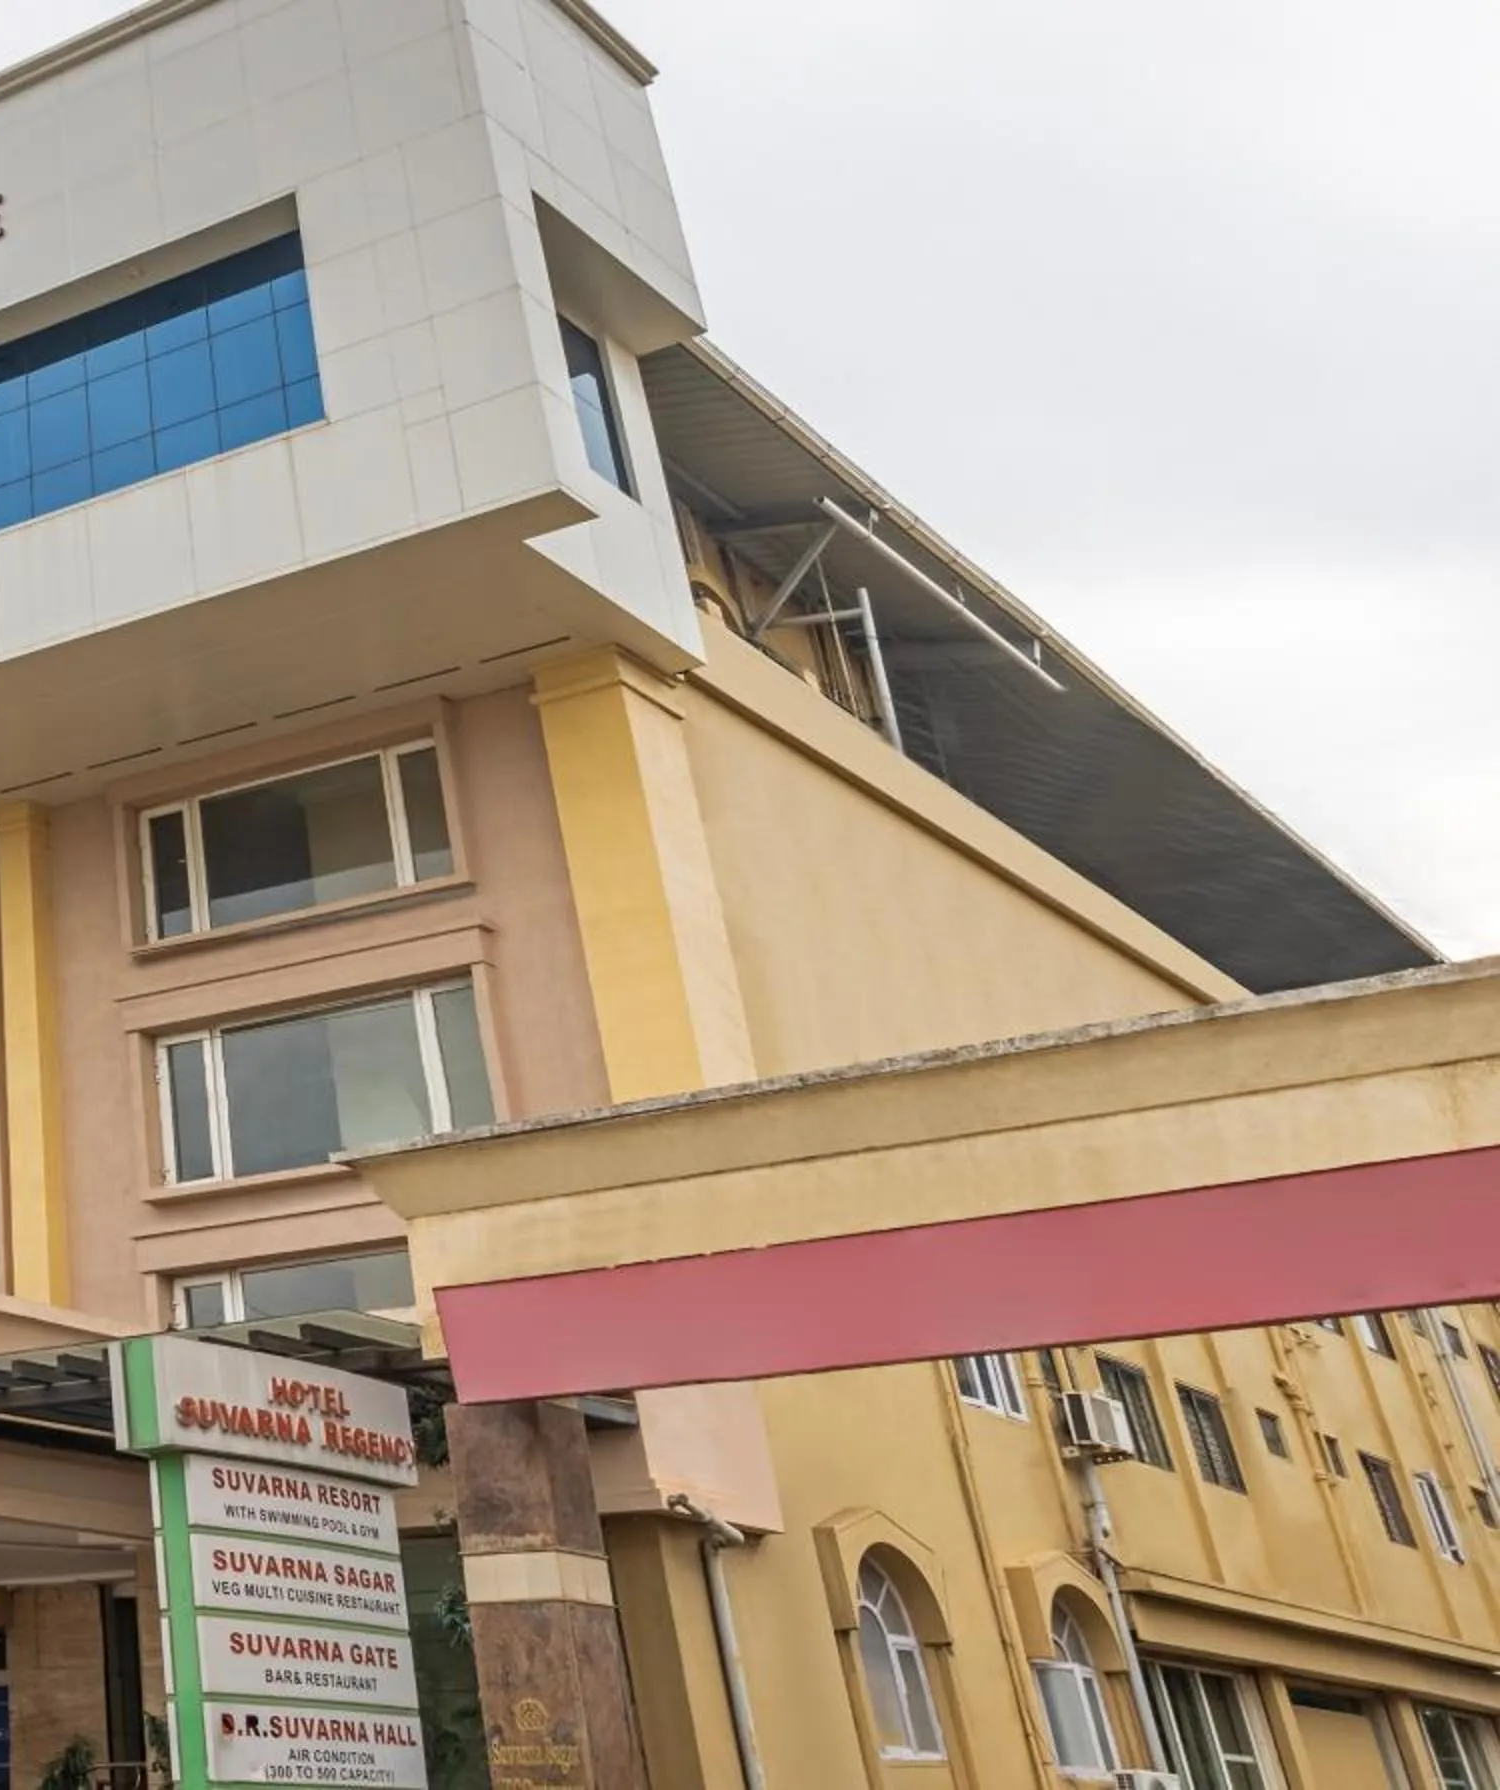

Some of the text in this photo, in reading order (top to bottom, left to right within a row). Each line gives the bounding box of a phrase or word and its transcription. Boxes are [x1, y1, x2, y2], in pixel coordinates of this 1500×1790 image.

[268, 1376, 351, 1418] HOTEL
[175, 1396, 417, 1469] SUVARNA REGENCY
[211, 1466, 381, 1514] SUVARNA RESORT
[223, 1503, 257, 1520] WITH
[259, 1507, 319, 1529] SWIMMING
[321, 1517, 348, 1534] POOL
[360, 1523, 380, 1539] GYM
[212, 1549, 397, 1593] SUVARNA SAGAR
[211, 1579, 401, 1615] VEG MULTI CUISINE RESTAURANT
[229, 1631, 399, 1670] SUVARNA GATE
[306, 1671, 378, 1693] RESTAURANT
[373, 1722, 417, 1747] HALL
[288, 1749, 376, 1766] AIR CONDITION
[298, 1766, 314, 1780] TO
